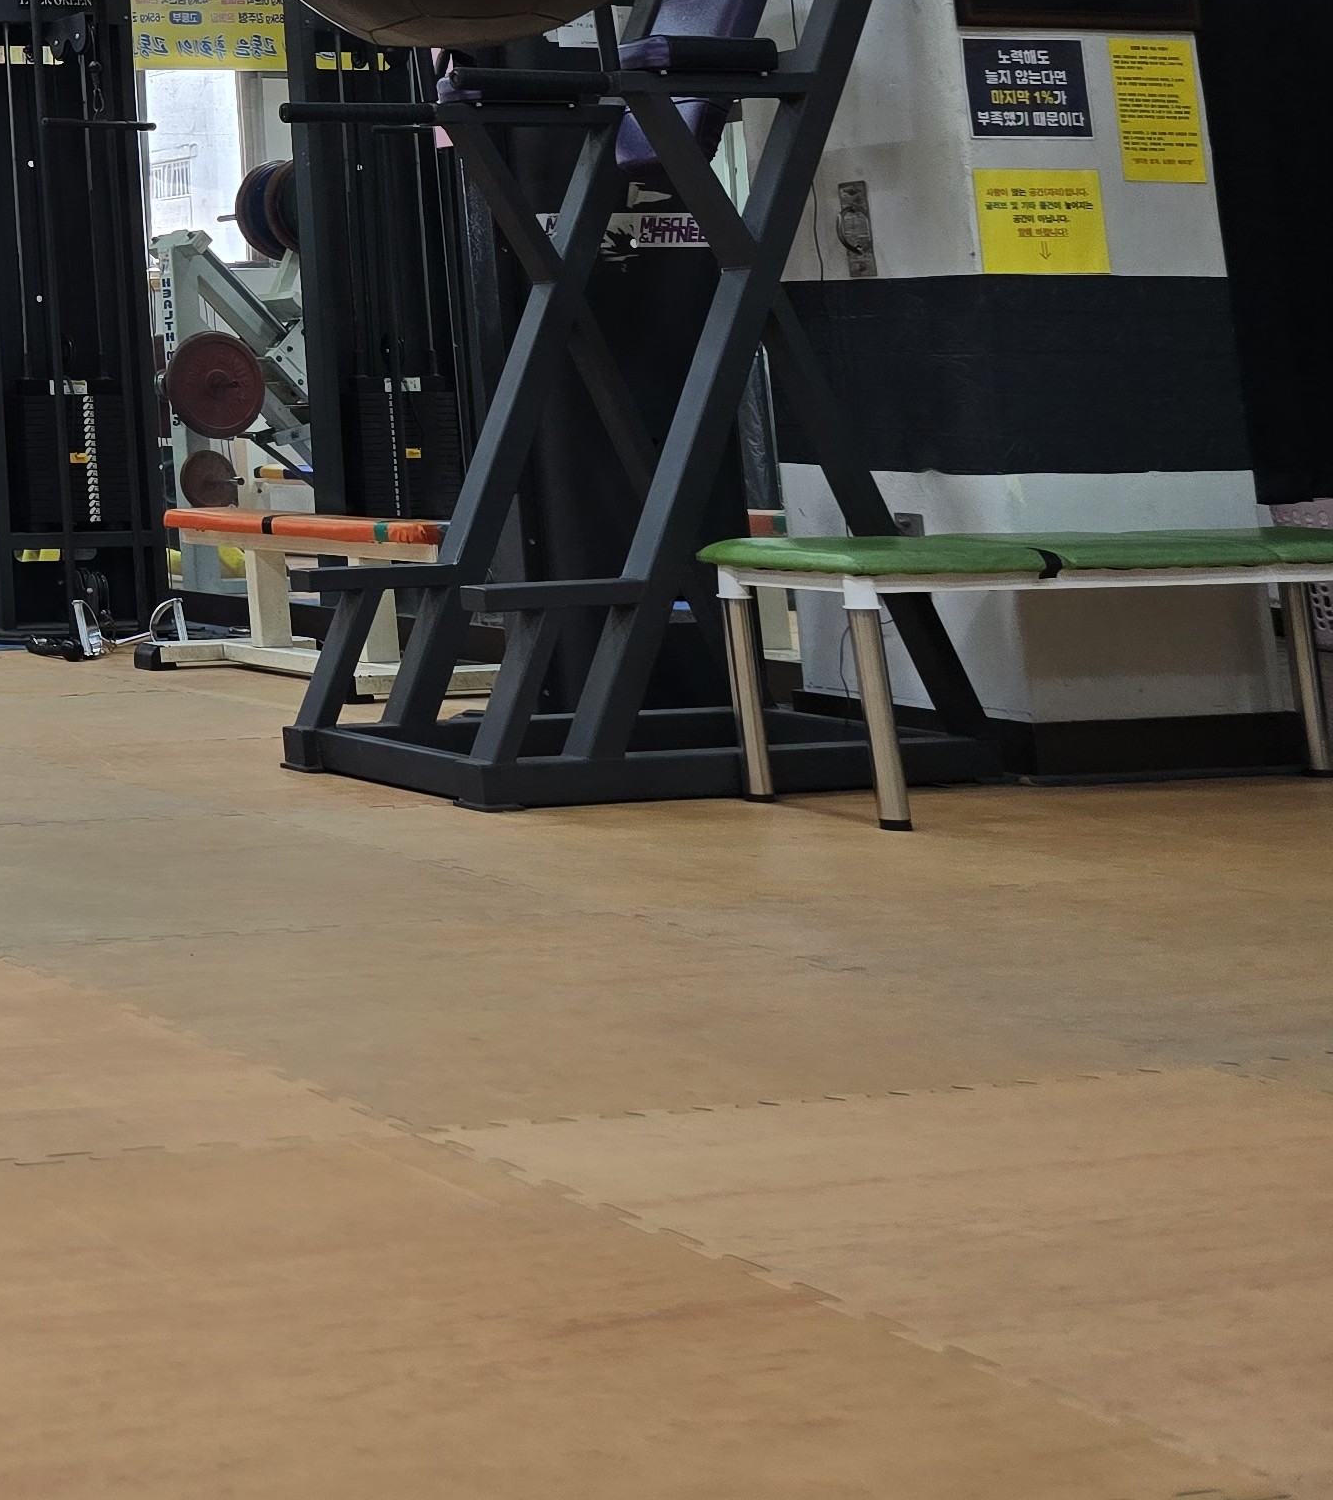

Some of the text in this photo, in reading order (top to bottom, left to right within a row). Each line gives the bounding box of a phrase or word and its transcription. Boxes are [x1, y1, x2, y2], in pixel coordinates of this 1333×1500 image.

[997, 49, 1051, 65] 노력해도
[984, 69, 1068, 85] 늘지 않는다면
[990, 89, 1068, 105] 마지막 1%가
[977, 110, 1085, 127] 부족했기 때문이다
[640, 216, 696, 233] MUSCLE
